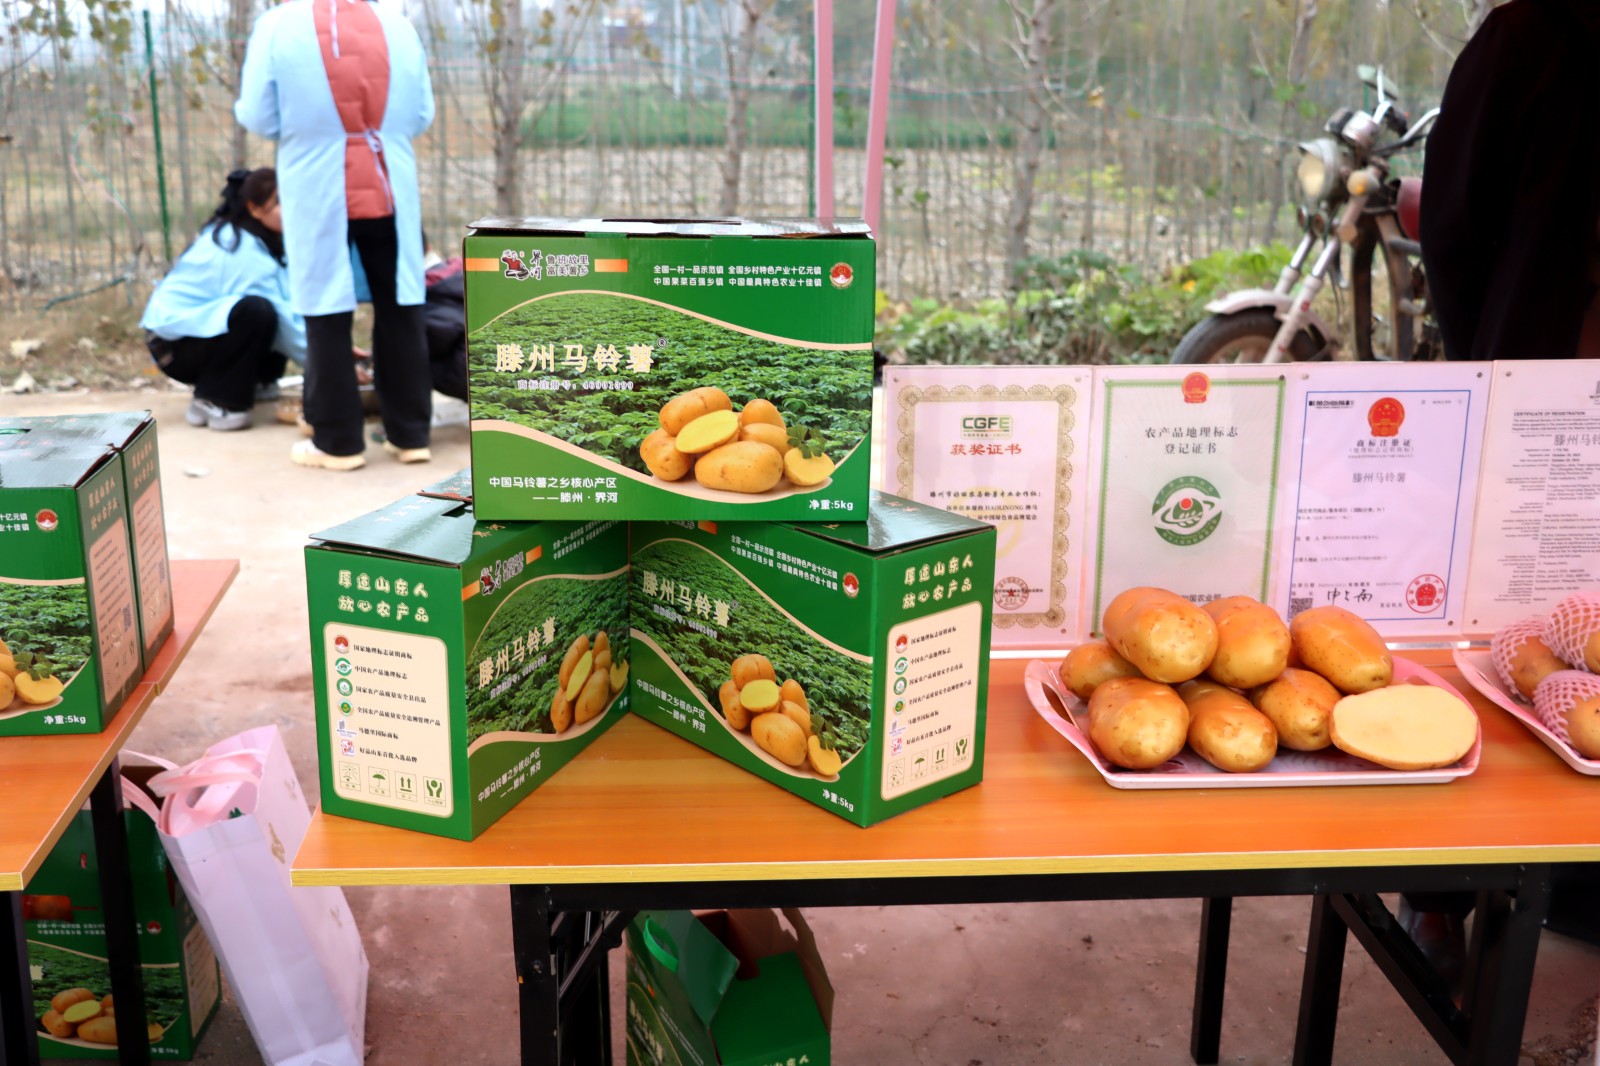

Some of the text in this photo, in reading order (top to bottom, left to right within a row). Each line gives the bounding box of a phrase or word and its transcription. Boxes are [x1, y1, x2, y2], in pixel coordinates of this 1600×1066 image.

[653, 265, 822, 275] 全国一村一品示范镇 全国乡村特色产业十亿元镇
[653, 277, 724, 286] 中国果菜百强乡镇
[495, 343, 654, 373] 滕州马铃薯
[963, 417, 1010, 429] CGFE
[1145, 426, 1238, 438] 农产品地理标志
[950, 443, 1022, 455] 获奖证书
[1165, 442, 1217, 454] 登记证书
[489, 477, 617, 488] 中国马铃薯之乡核心产区
[1352, 472, 1407, 483] 滕州马铃薯
[904, 554, 974, 586] 厚道山东人
[338, 570, 429, 598] 厚道山东人
[902, 577, 972, 610] 放心农产品
[337, 595, 430, 623] 放心农产品
[642, 570, 731, 628] 滕州马铃薯
[478, 615, 556, 690] 滕州马铃薯
[636, 679, 705, 720] 中国马铃薯之乡核心产区
